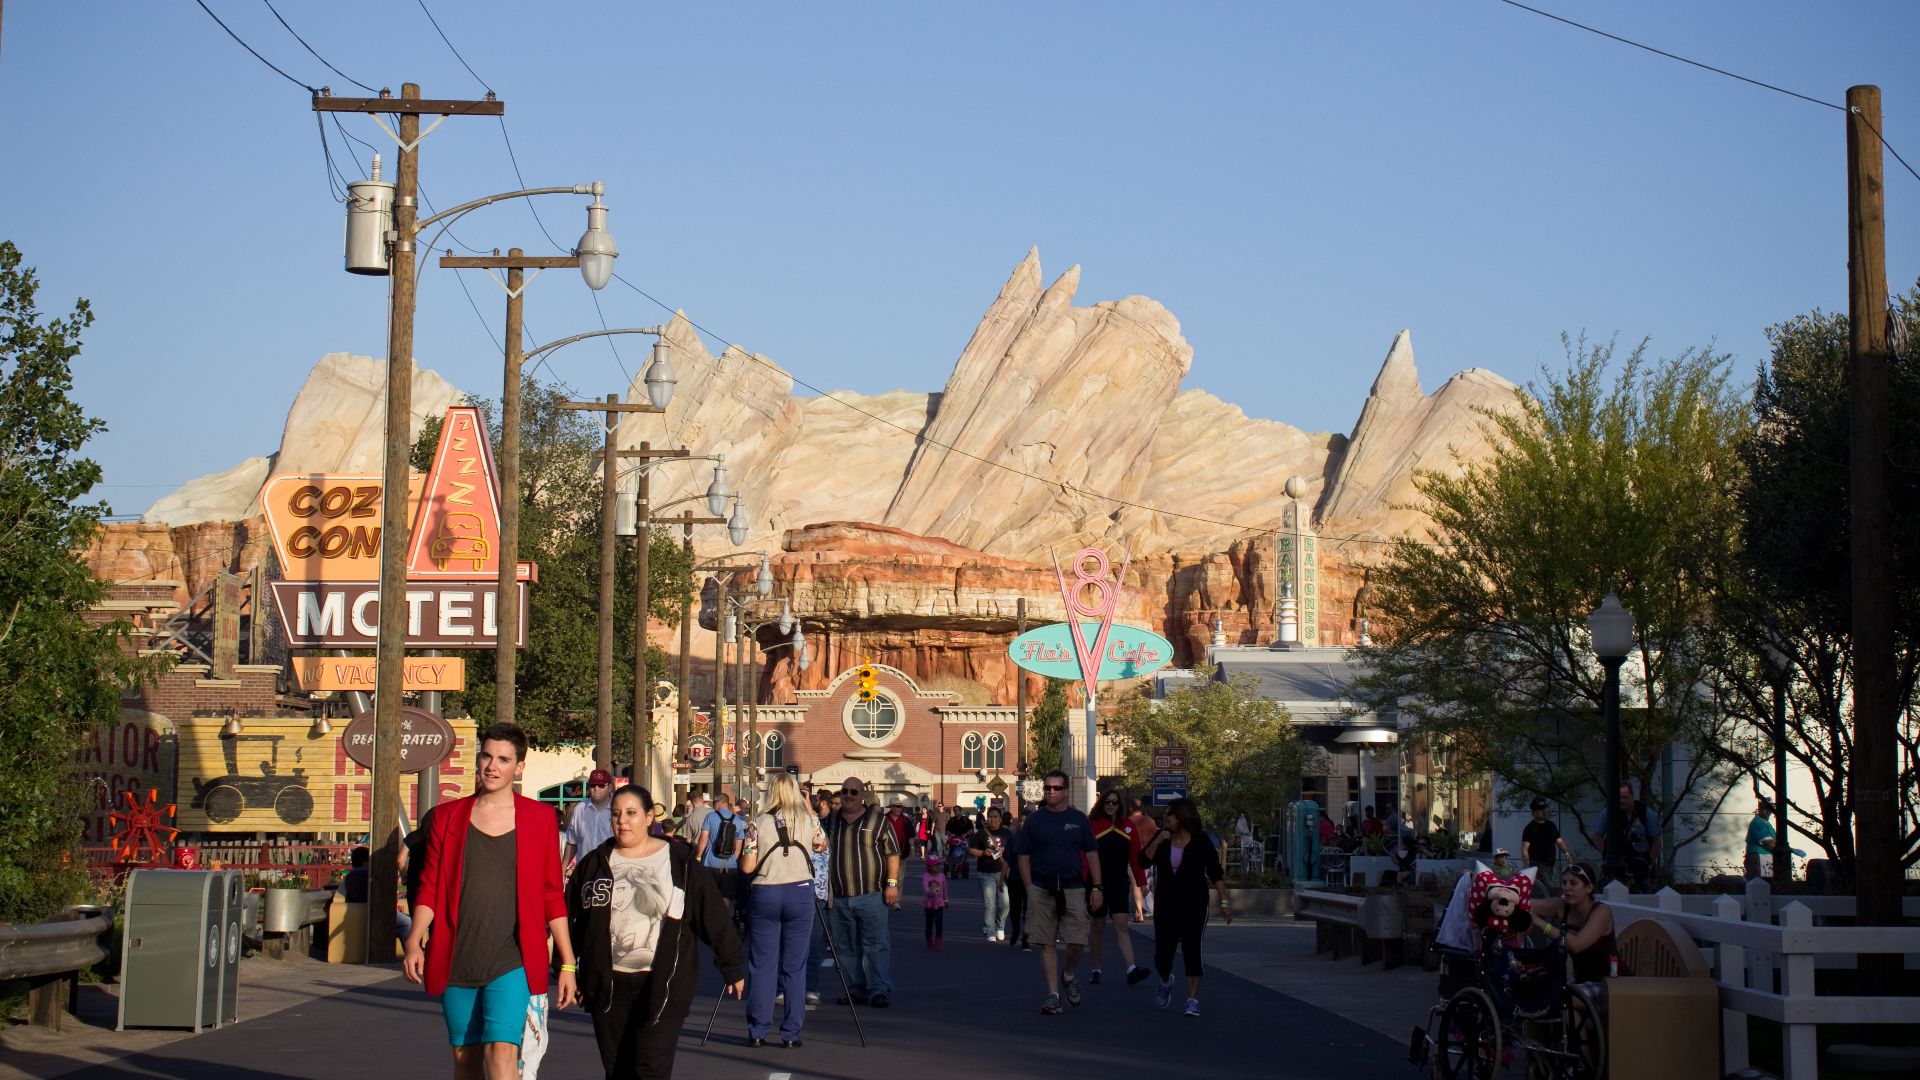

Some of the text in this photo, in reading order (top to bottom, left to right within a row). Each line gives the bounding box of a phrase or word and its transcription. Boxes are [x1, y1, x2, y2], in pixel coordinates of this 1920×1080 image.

[288, 485, 412, 518] COZ
[287, 525, 412, 559] CON
[1020, 641, 1073, 663] Flo's
[302, 663, 447, 685] NO VACNCY
